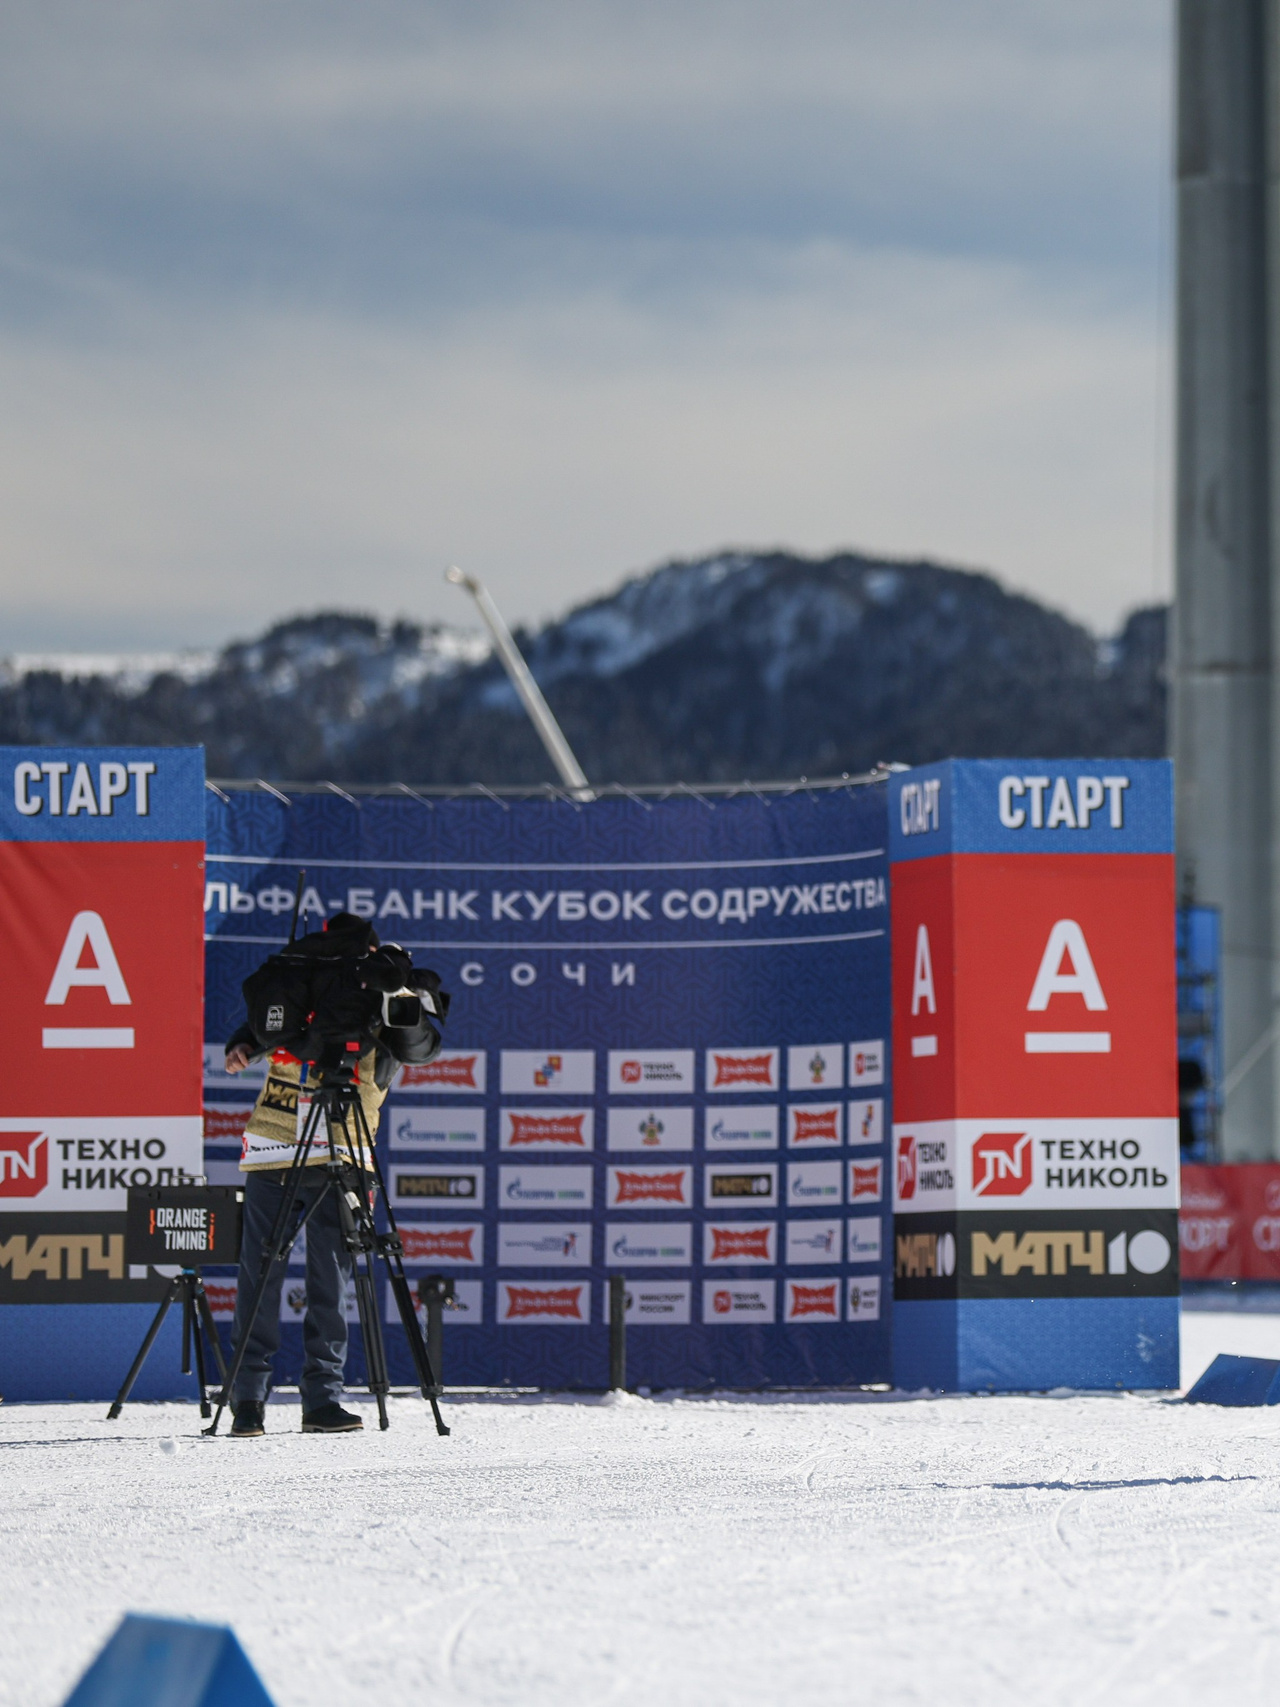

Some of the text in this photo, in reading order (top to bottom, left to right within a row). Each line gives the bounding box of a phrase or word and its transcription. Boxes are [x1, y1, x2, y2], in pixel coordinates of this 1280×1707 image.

[14, 762, 156, 816] СТАРТ
[901, 778, 941, 836] СТАРТ
[999, 775, 1130, 829] СТАРТ
[204, 876, 886, 925] ЛЬФА-БАНК КУБОК СОДРУЖЕСТВА
[262, 1082, 298, 1110] МАТ
[56, 1138, 167, 1160] ТЕХНО
[917, 1142, 947, 1164] ТЕХНО
[1040, 1139, 1141, 1160] ТЕХНО
[919, 1170, 955, 1191] НИКОЛЬ
[1046, 1167, 1169, 1188] НИКОЛЬ
[156, 1207, 208, 1229] ORANGE
[164, 1229, 208, 1250] TIMING
